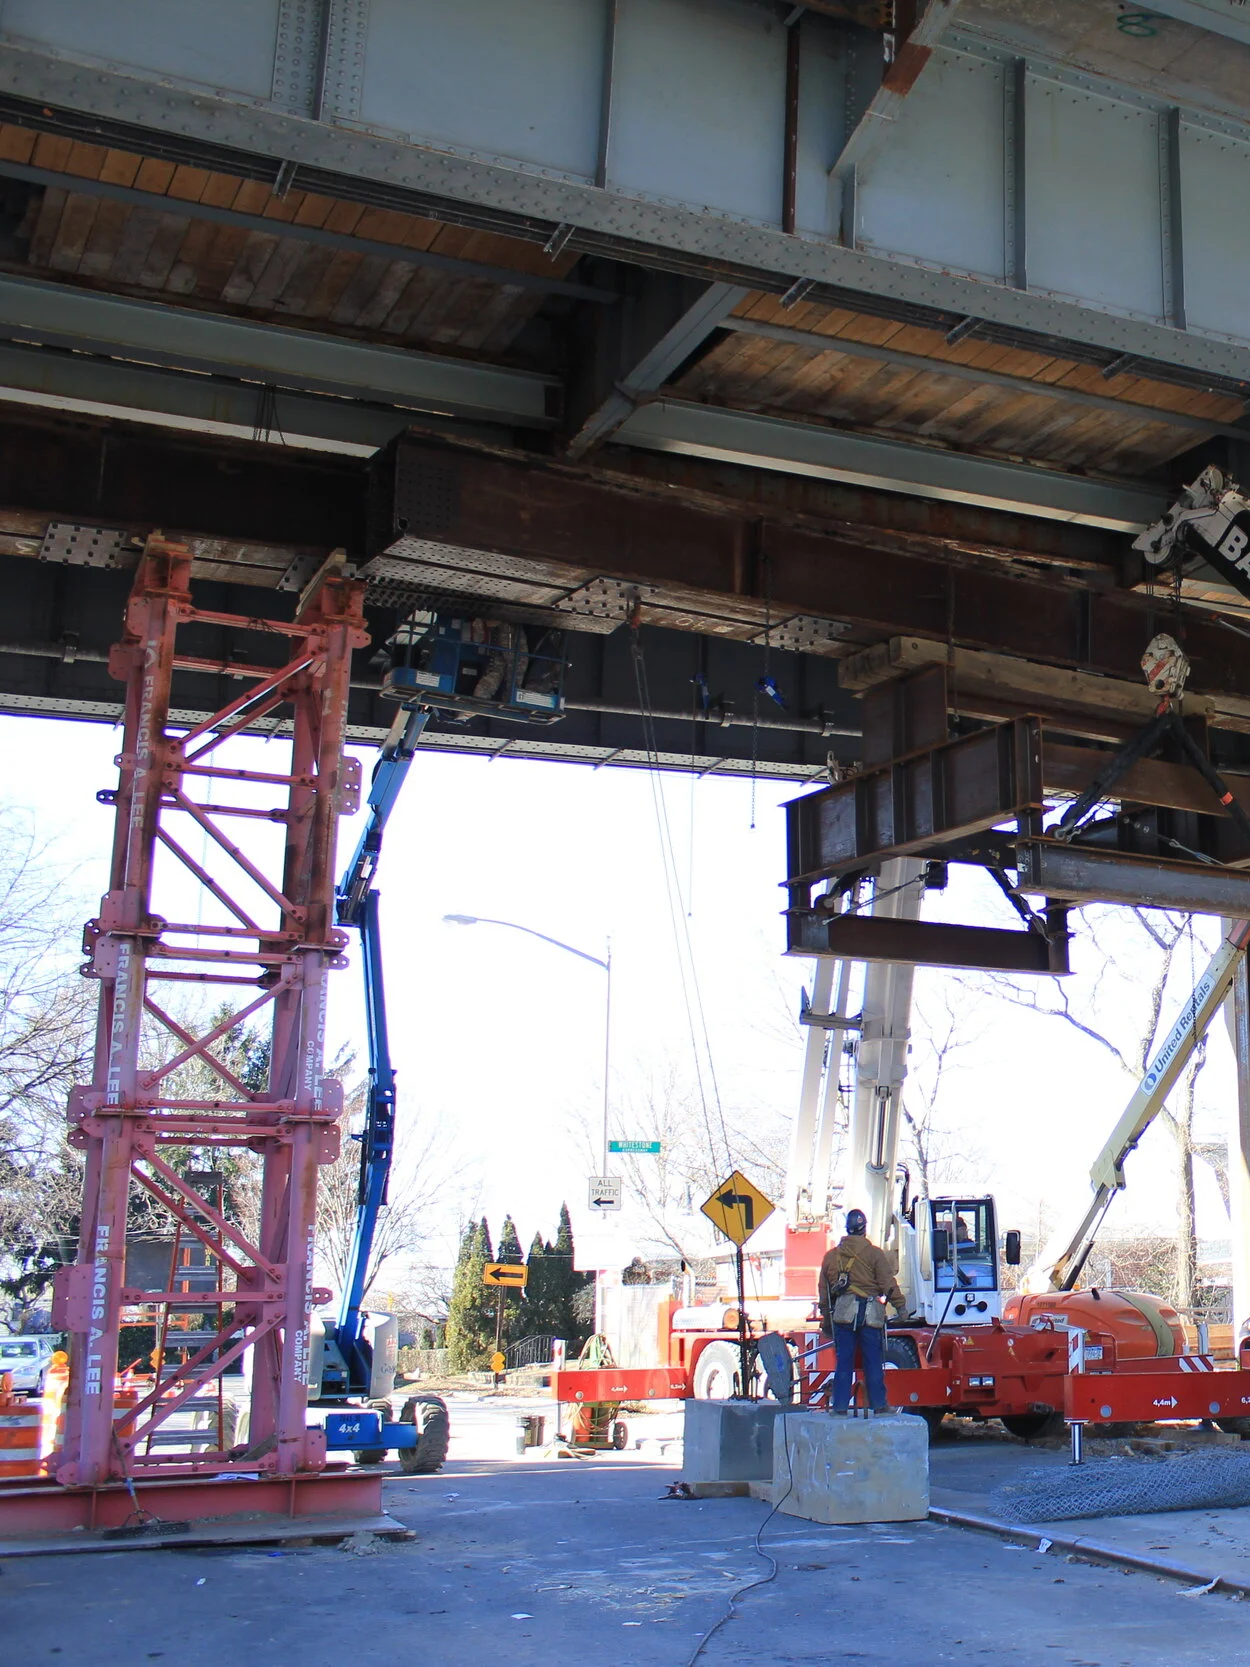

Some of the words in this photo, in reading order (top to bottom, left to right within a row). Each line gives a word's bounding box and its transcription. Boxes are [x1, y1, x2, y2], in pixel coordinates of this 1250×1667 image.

[137, 674, 155, 761] FRANCIS
[131, 791, 145, 828] LEE
[112, 943, 131, 1034] FRANCIS
[1154, 1028, 1182, 1075] United
[1179, 981, 1211, 1031] Rentals
[305, 1040, 315, 1092] COMPANY
[107, 1067, 121, 1105] LEE
[313, 1074, 323, 1111] LEE
[618, 1141, 653, 1149] WHITESTONE
[591, 1188, 619, 1196] TRAFFIC
[597, 1179, 613, 1187] ALL
[91, 1224, 112, 1321] FRANCIS
[84, 1354, 102, 1395] LEE
[293, 1329, 304, 1384] COMPANY
[301, 1346, 310, 1385] LEE
[1152, 1398, 1172, 1408] 4,4m
[339, 1423, 361, 1433] 4x4
